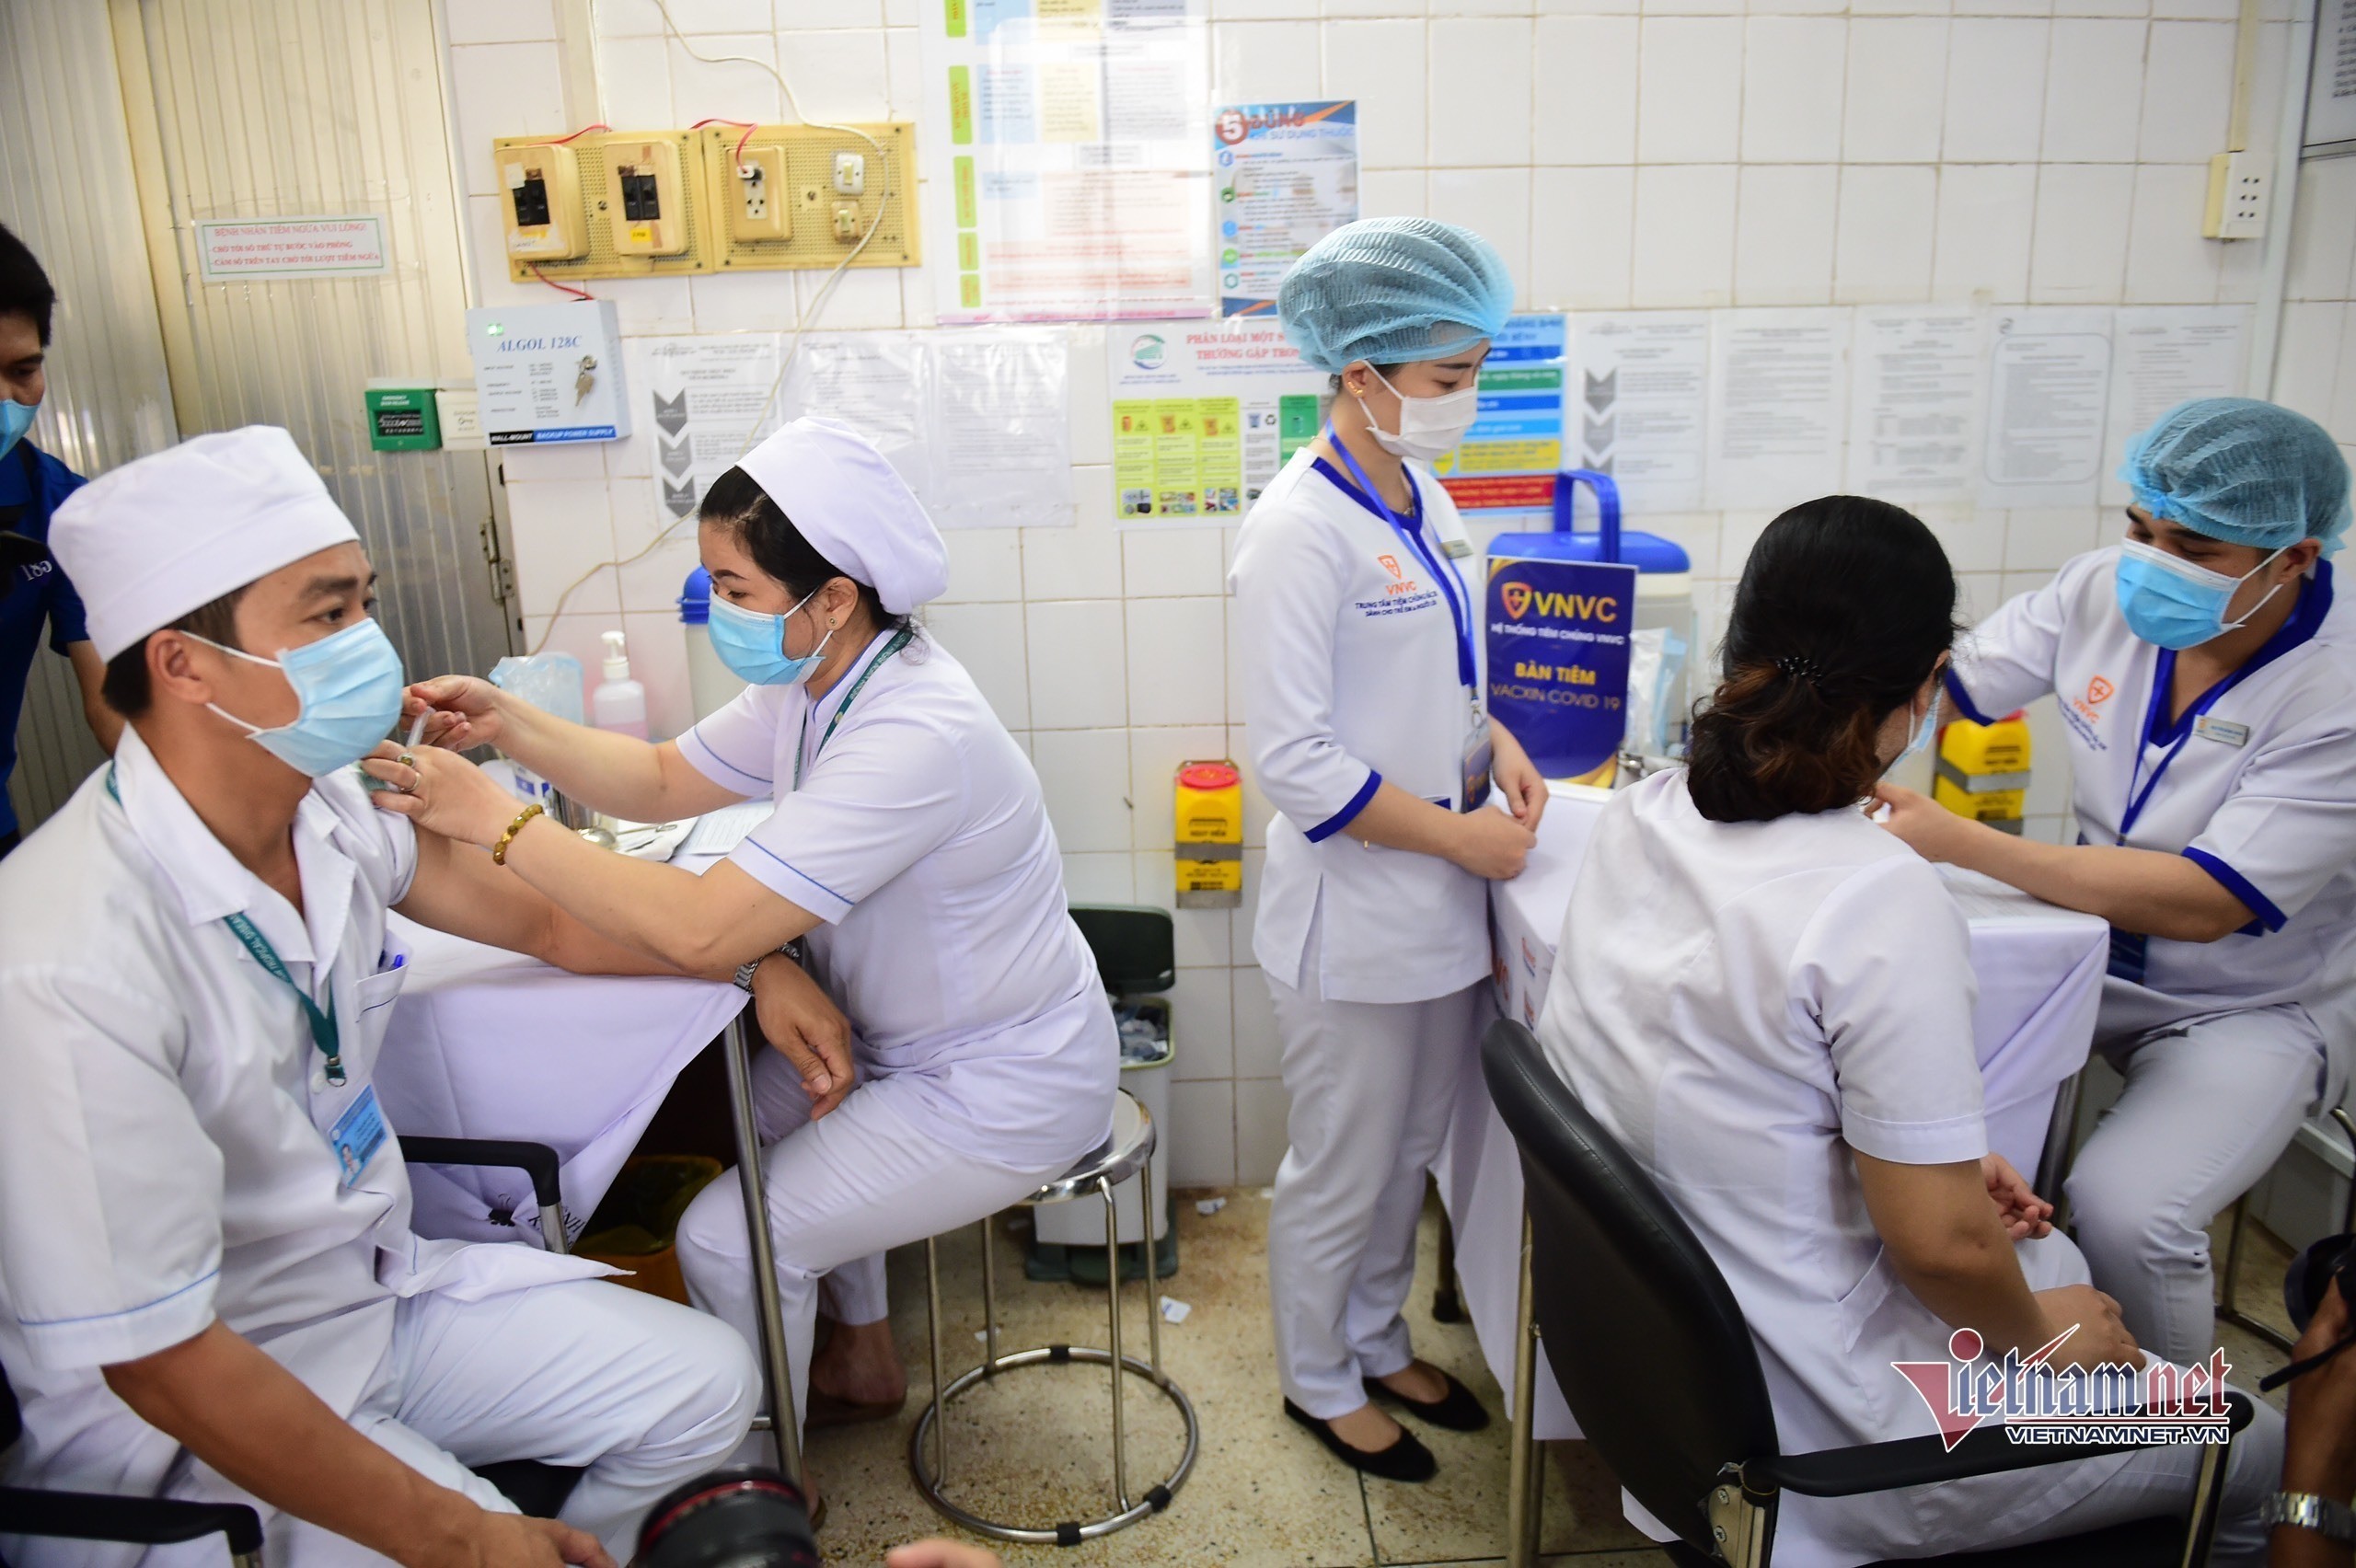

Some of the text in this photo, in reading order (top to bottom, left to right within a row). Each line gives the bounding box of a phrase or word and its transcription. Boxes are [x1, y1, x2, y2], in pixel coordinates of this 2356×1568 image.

[1221, 111, 1242, 141] 5
[496, 335, 583, 353] ALGOL 128C
[1386, 581, 1418, 595] VNVC
[1533, 591, 1618, 623] VNVC
[1490, 622, 1625, 646] HỆ THỐNG TIÊM CHỦNG VNVC
[1515, 659, 1597, 686] BÀN TIÊM
[1490, 683, 1622, 711] VACXIN COVID 19
